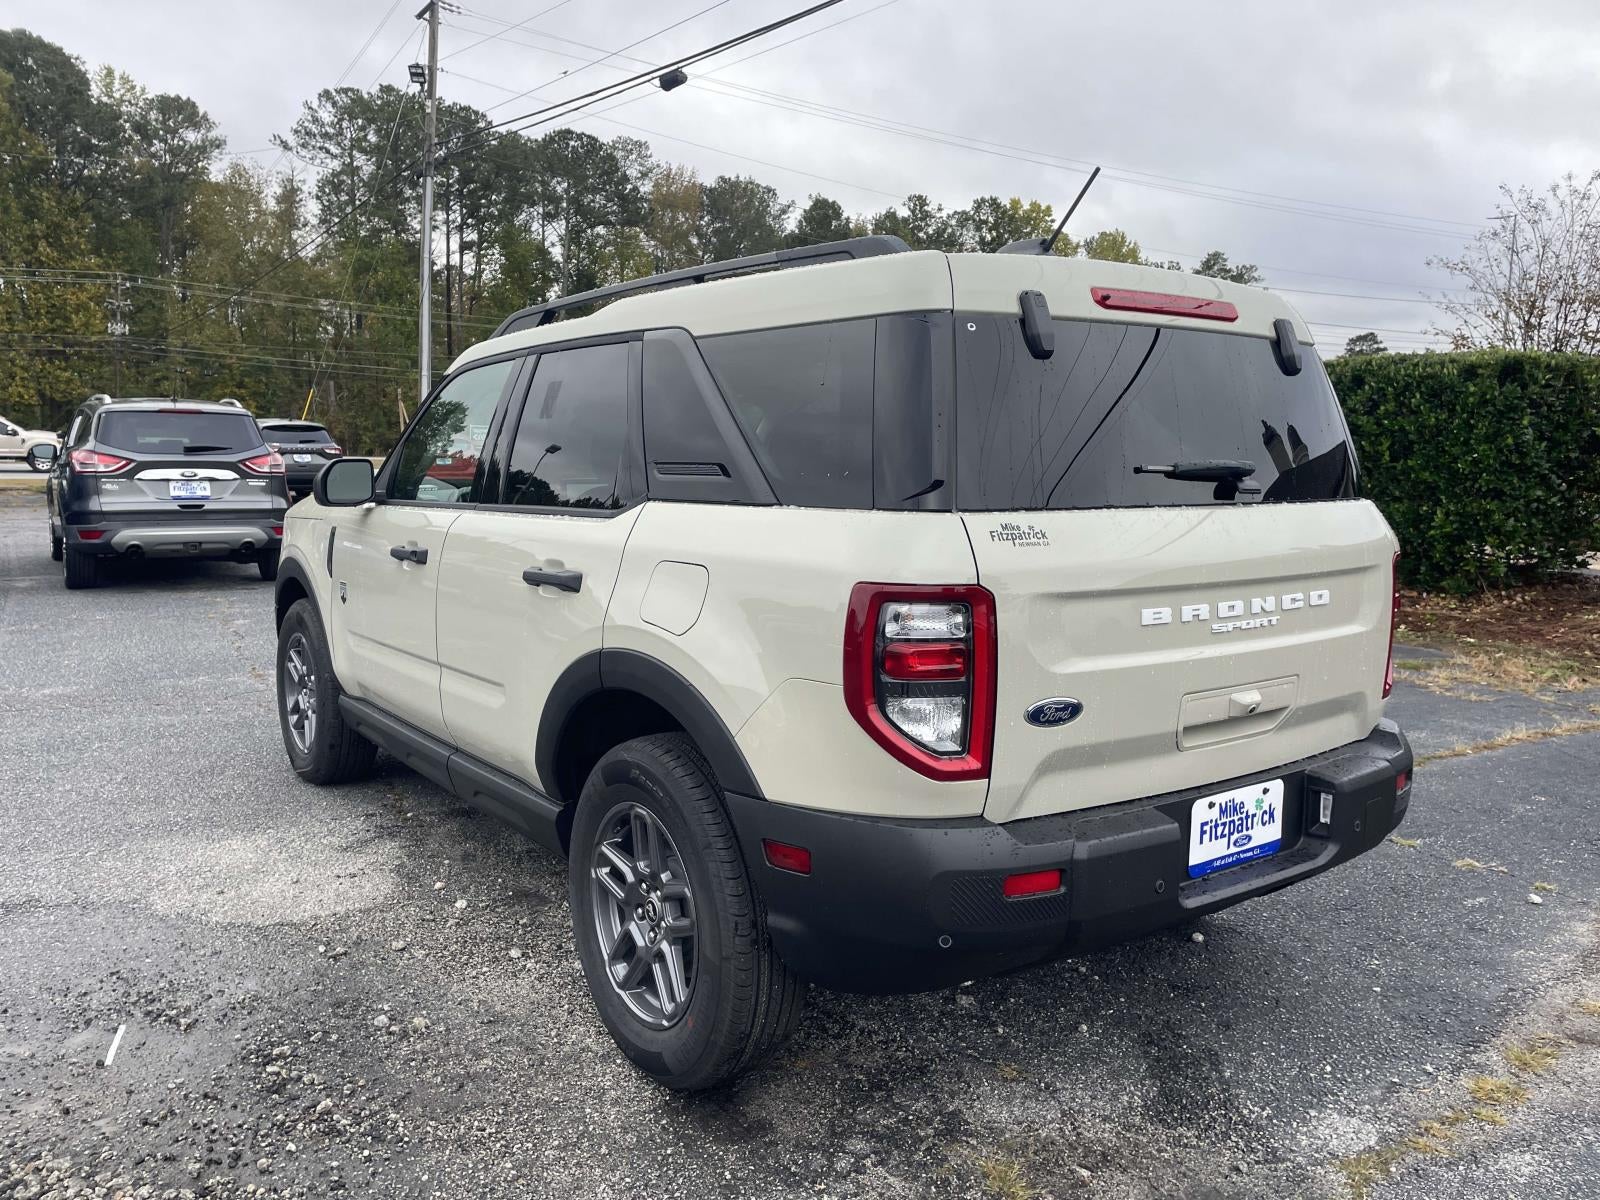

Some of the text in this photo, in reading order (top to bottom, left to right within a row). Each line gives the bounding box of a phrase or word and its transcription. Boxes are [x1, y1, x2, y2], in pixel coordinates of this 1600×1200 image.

[1000, 522, 1021, 532] Mike
[989, 529, 1049, 547] Fitzpatrick
[1141, 589, 1330, 626] BRONCO
[1211, 616, 1280, 633] SPORT
[1219, 798, 1245, 820] Mike
[1199, 802, 1276, 850] Fitzpatrick
